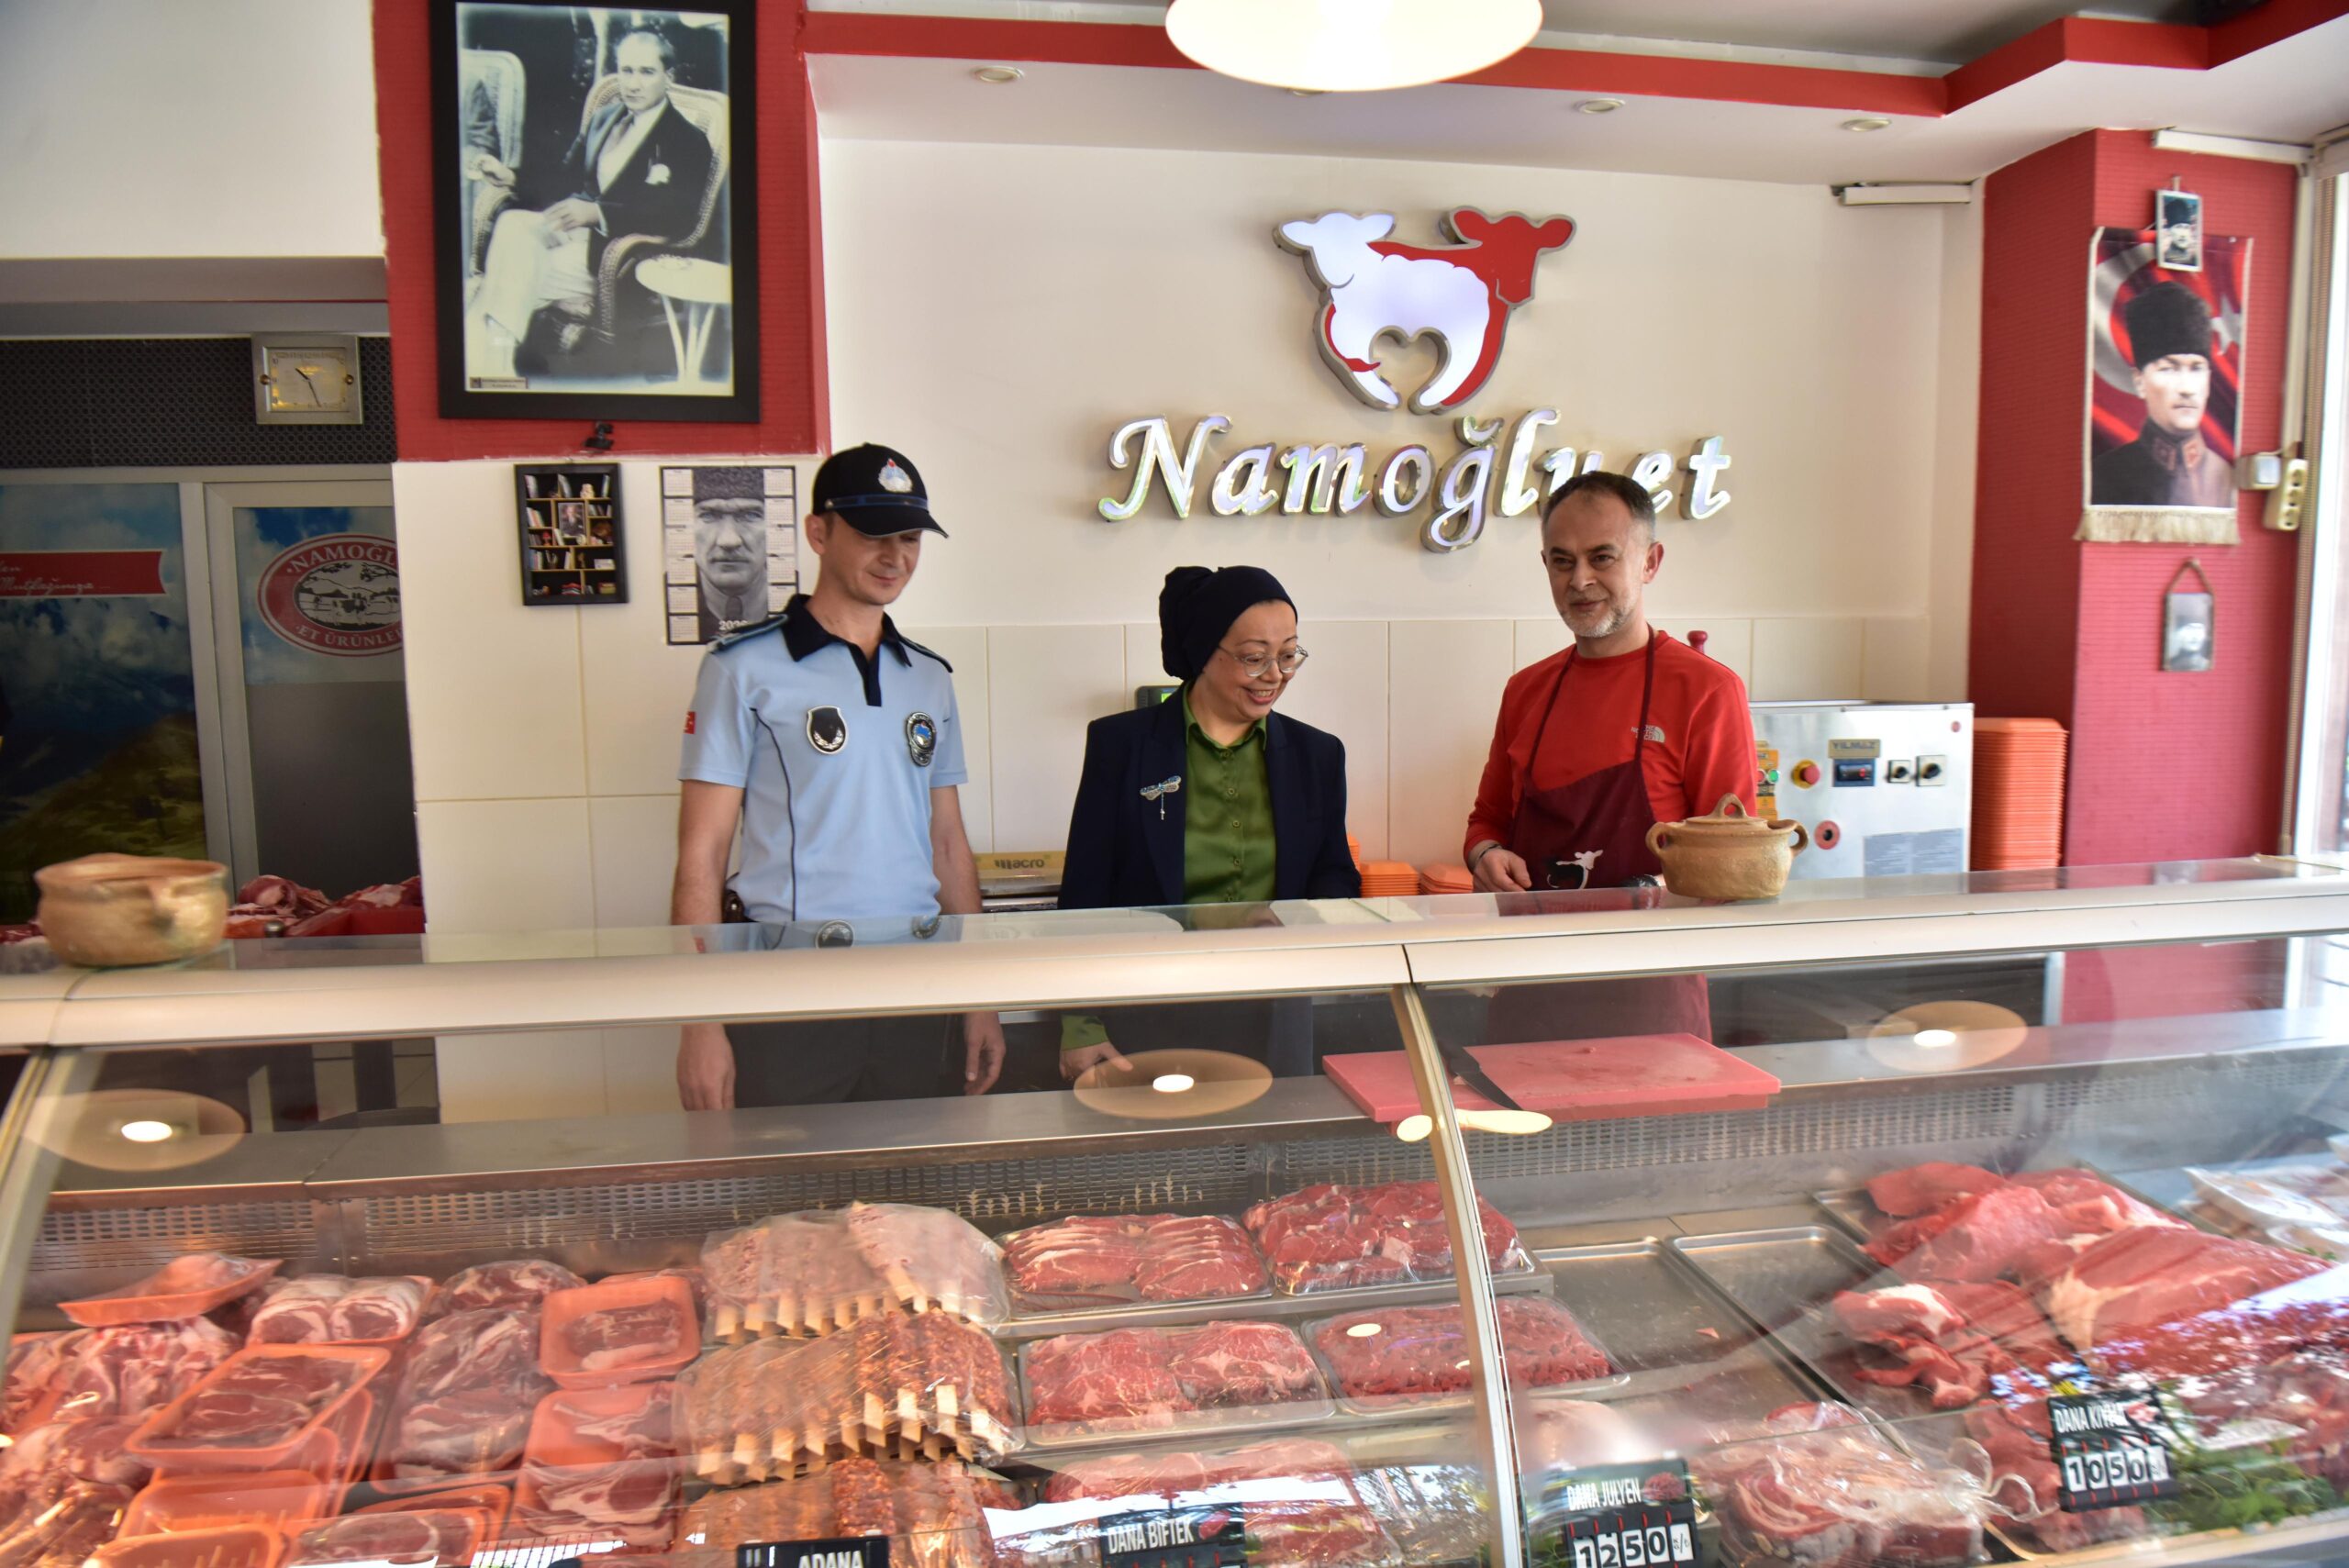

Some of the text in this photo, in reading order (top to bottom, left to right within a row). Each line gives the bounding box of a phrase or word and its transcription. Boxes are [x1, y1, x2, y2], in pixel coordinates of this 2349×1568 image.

[298, 626, 321, 640] ET
[2053, 1406, 2090, 1433] DANA
[2068, 1456, 2144, 1485] 1050
[1566, 1483, 1600, 1511] DANA
[1108, 1523, 1146, 1554] DANA
[1579, 1530, 1666, 1568] 1250
